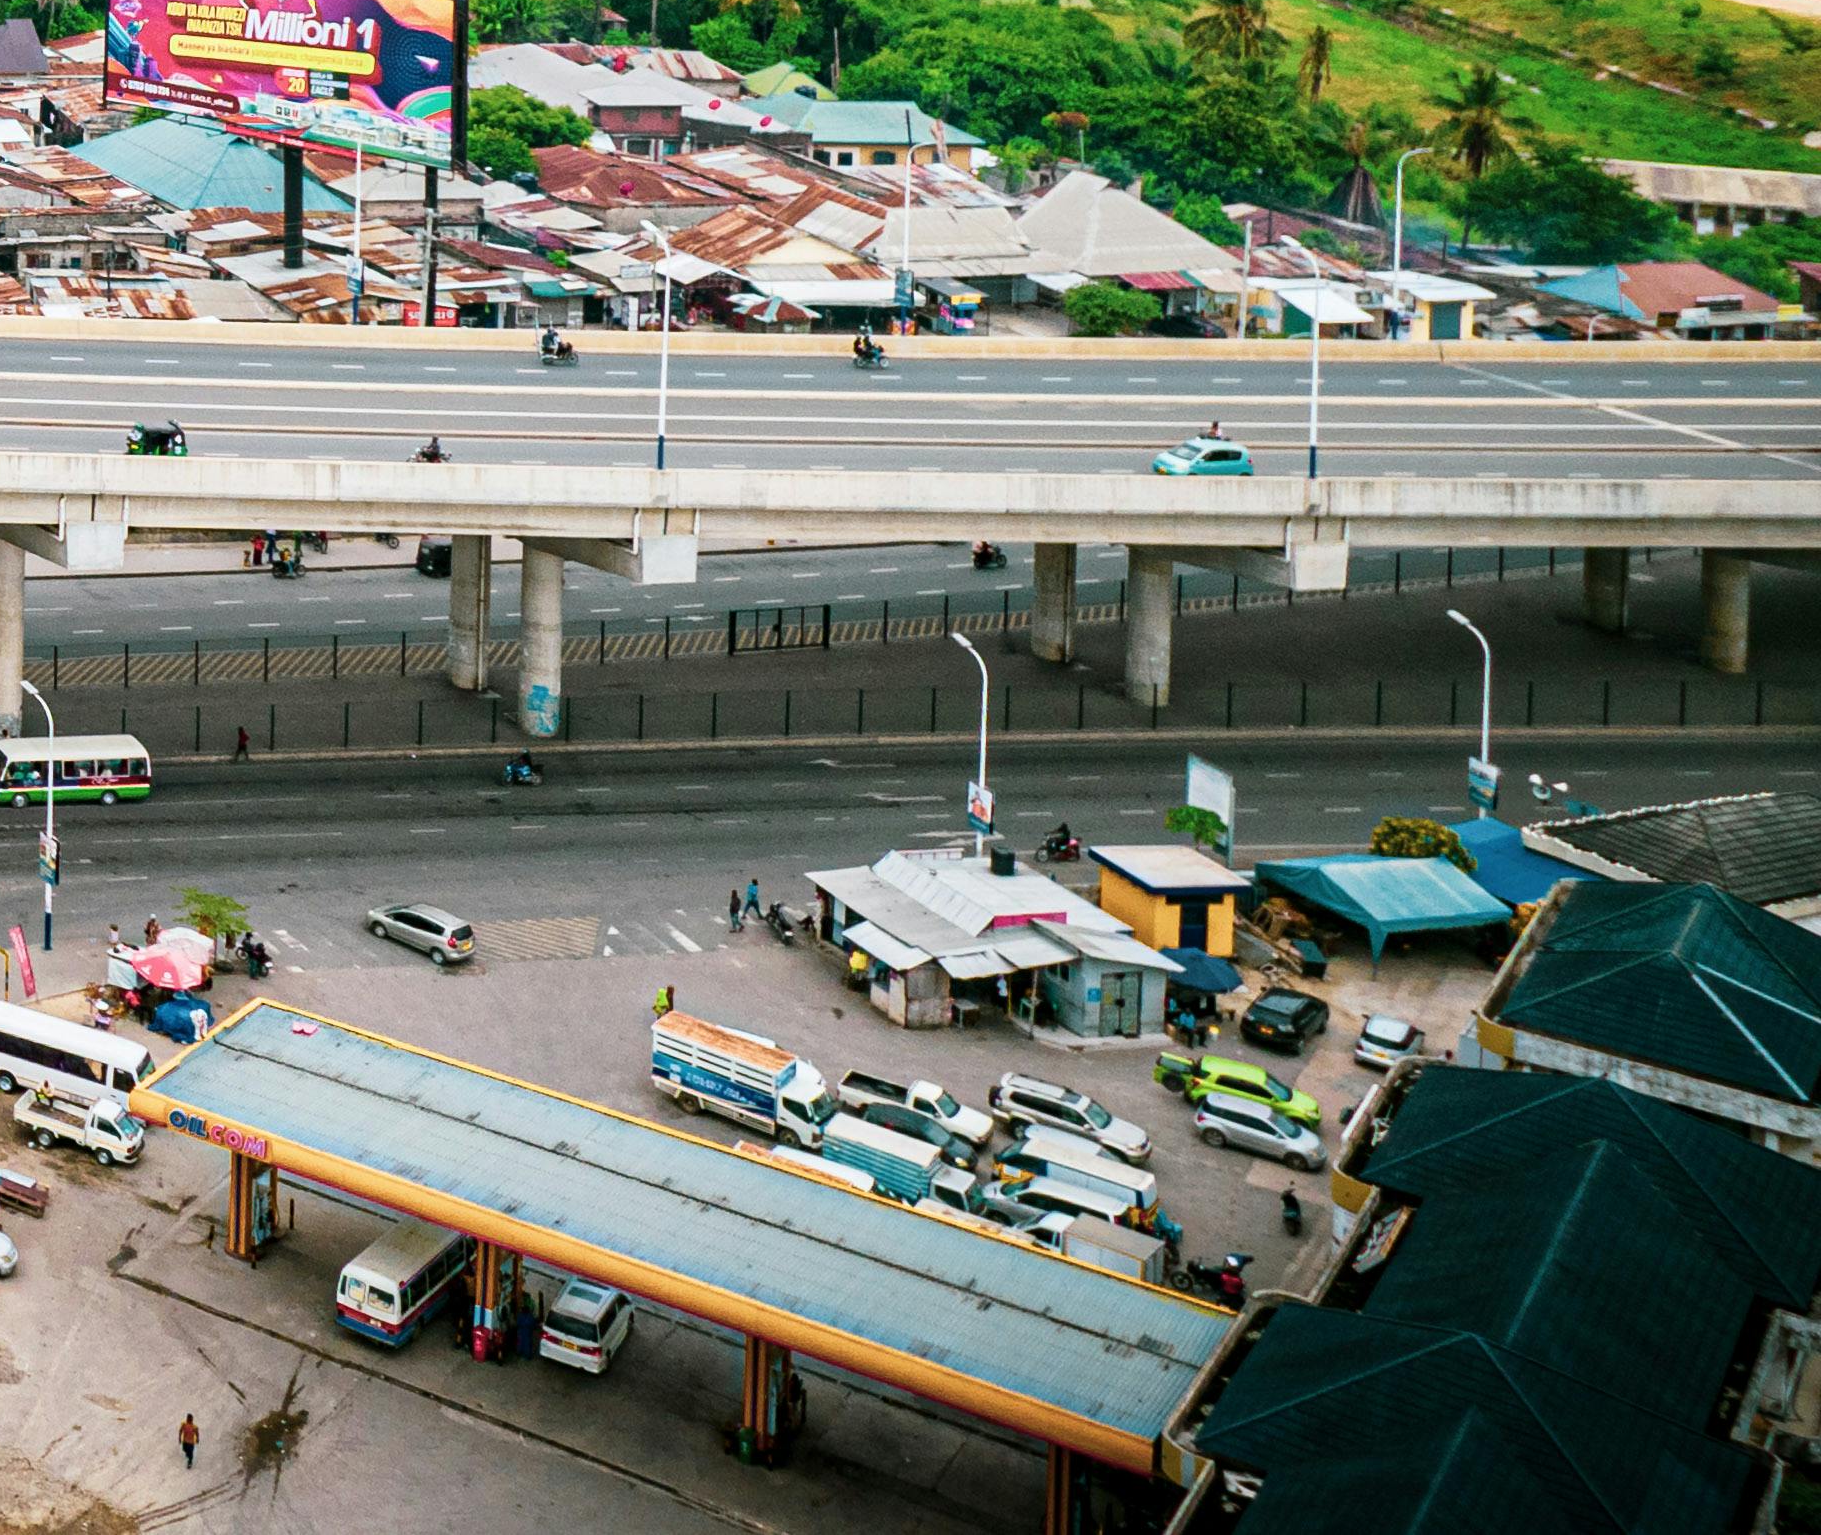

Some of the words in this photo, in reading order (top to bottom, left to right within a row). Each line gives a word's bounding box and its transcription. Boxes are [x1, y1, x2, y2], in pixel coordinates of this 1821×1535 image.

[244, 8, 351, 48] Millioni
[356, 18, 375, 49] 1
[288, 77, 306, 93] 20
